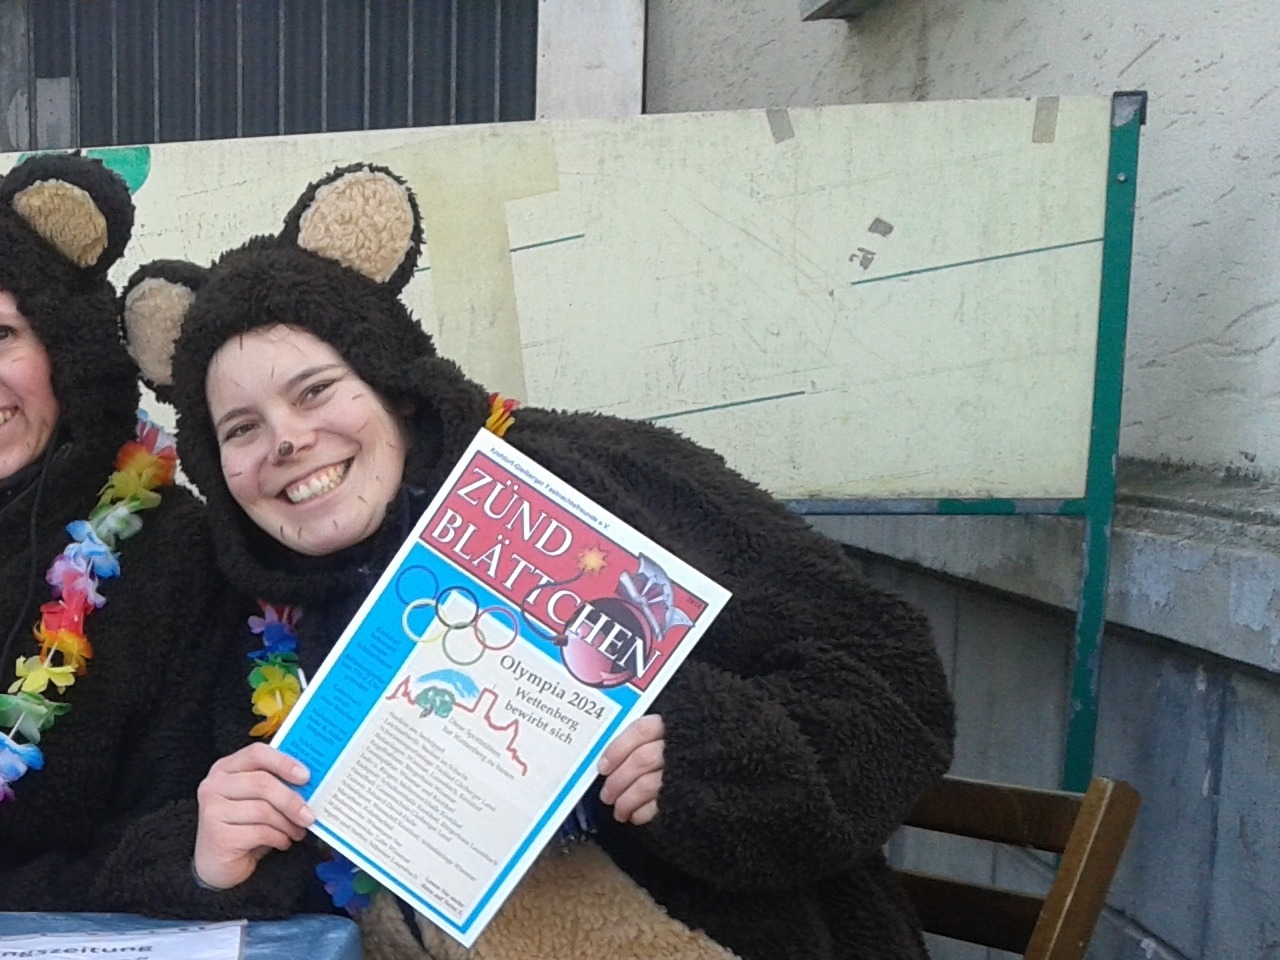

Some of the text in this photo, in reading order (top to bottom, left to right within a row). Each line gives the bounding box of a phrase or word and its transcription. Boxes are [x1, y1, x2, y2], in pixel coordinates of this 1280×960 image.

[456, 467, 573, 558] ZÜND
[430, 507, 662, 679] BLÄTTCHEN
[499, 654, 606, 721] Olympia 2024
[514, 687, 579, 733] Wettenberg
[504, 701, 575, 746] bewirbt sich
